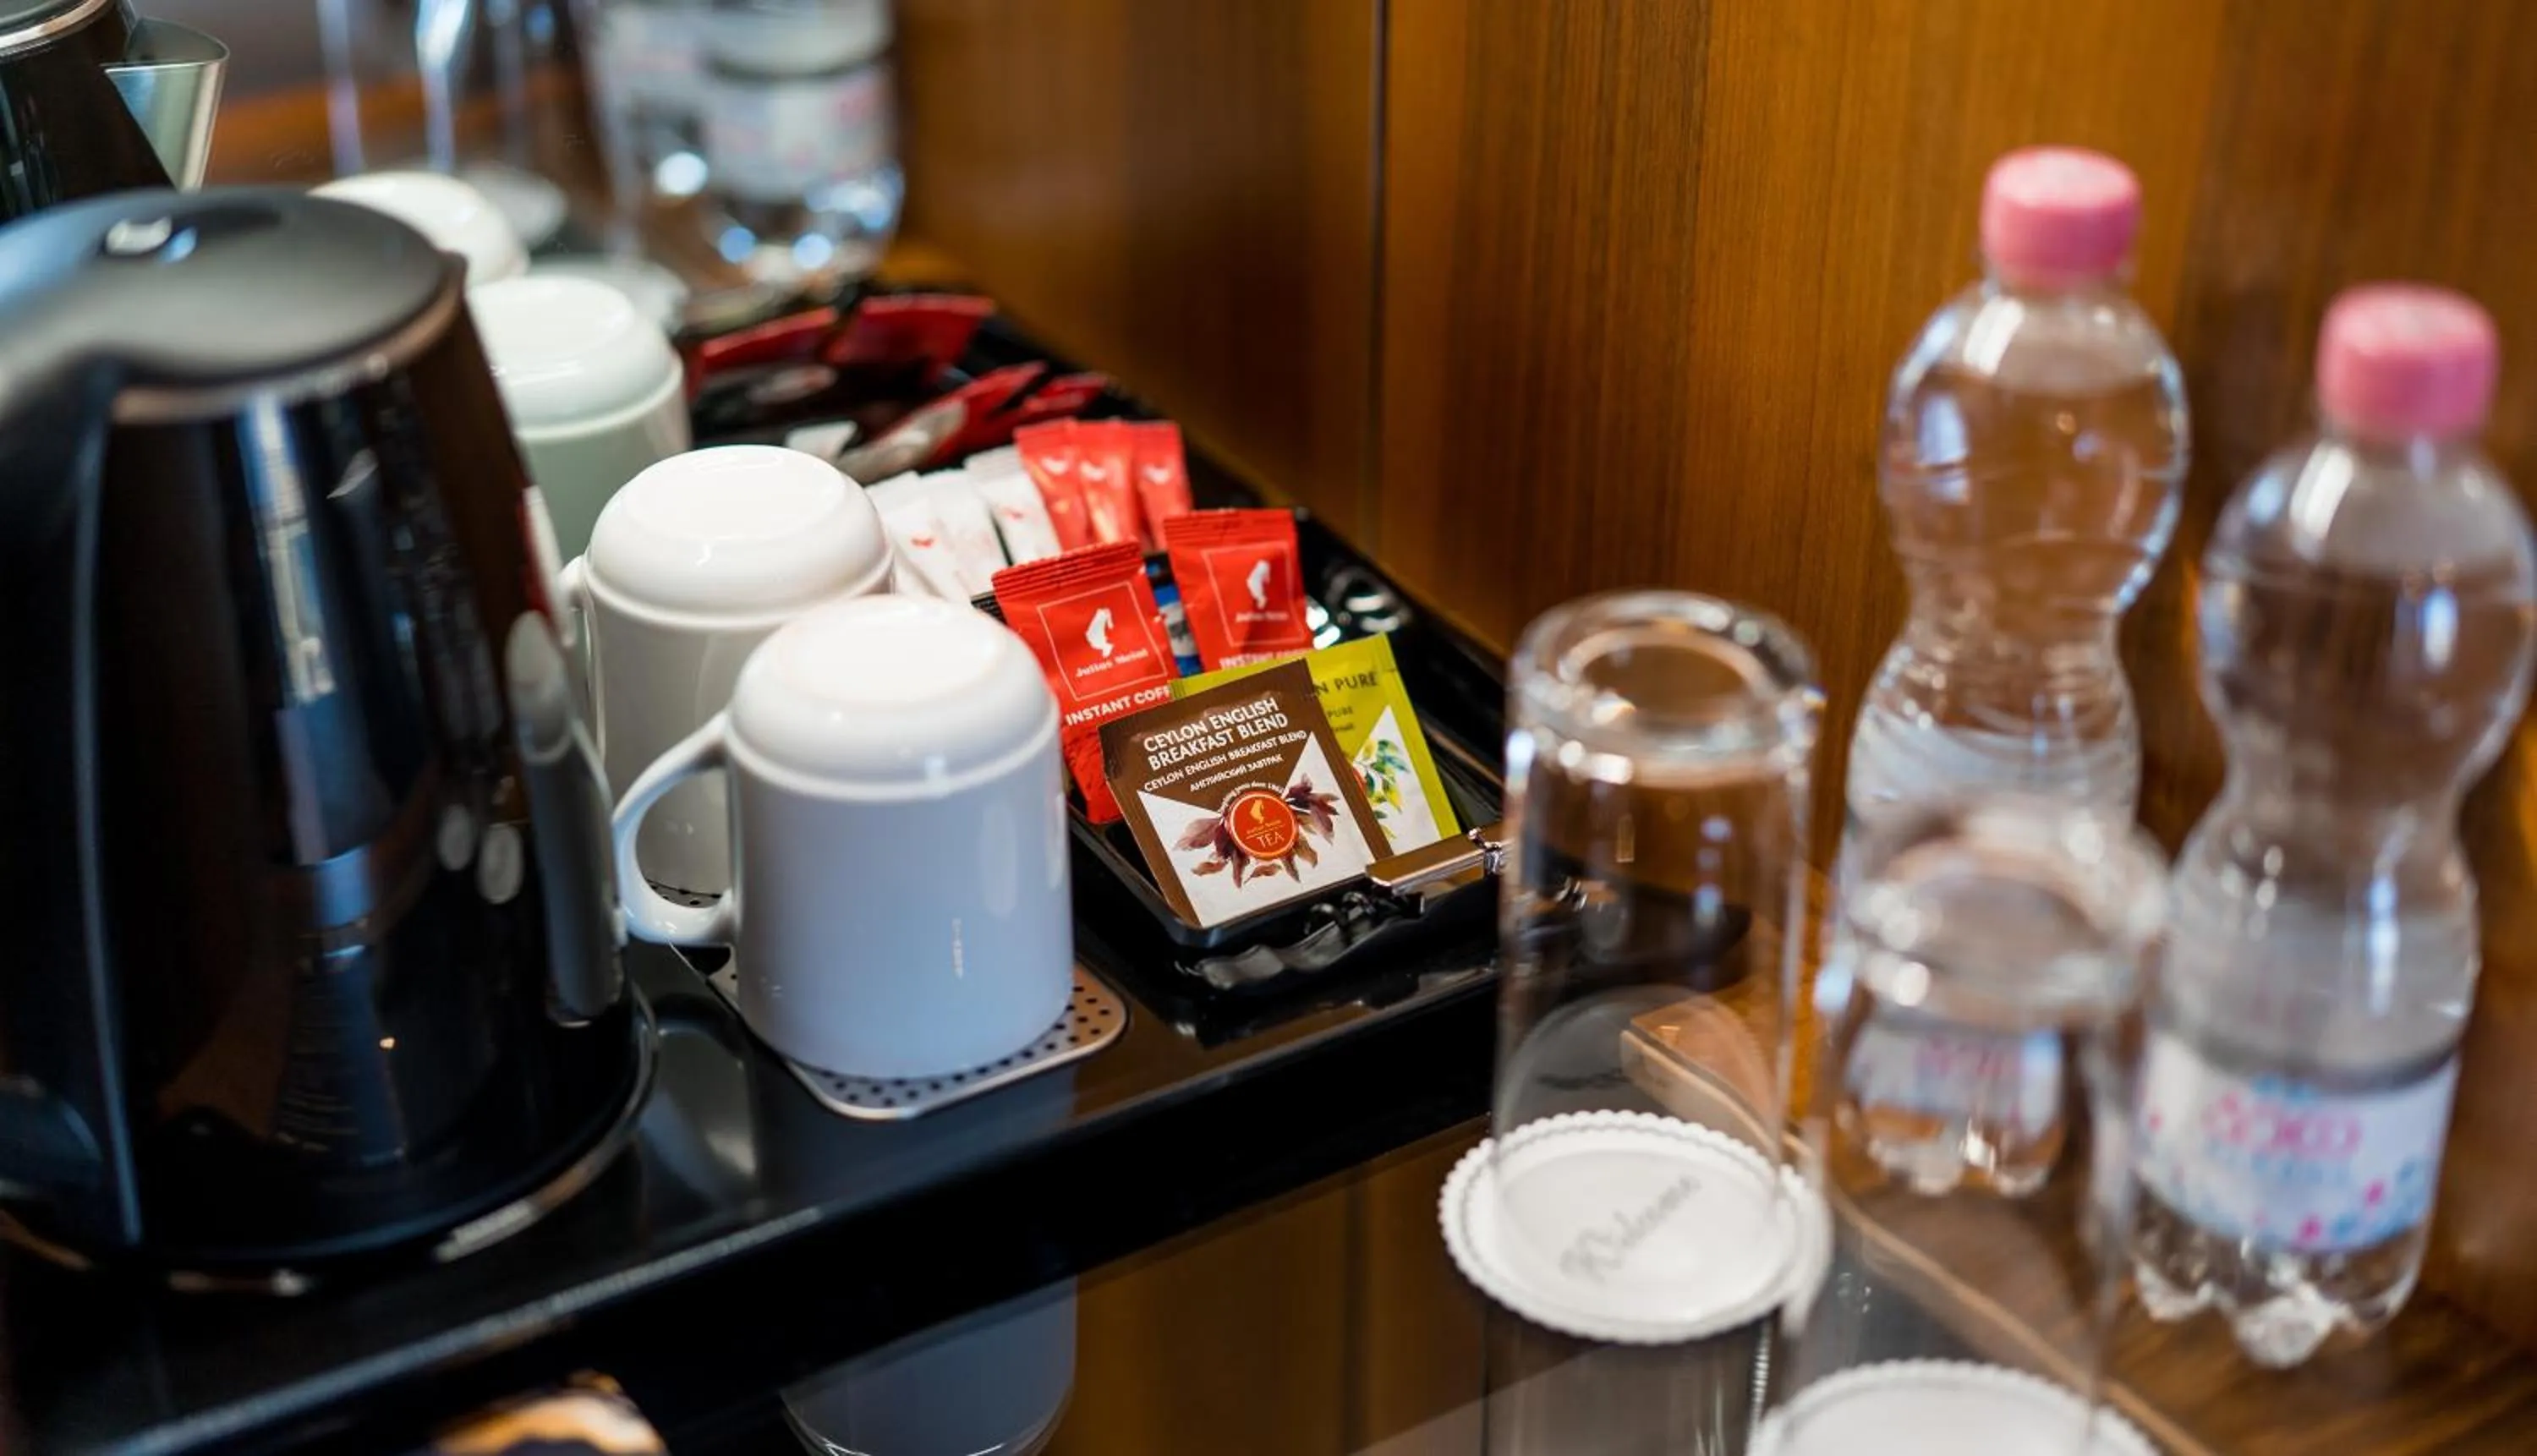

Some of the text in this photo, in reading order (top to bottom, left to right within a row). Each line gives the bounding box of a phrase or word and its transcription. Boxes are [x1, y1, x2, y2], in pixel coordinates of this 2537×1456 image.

[1334, 671, 1378, 690] PURE
[1066, 696, 1132, 725] INSTANT
[1143, 698, 1279, 752] CEYLON ENGLISH
[1148, 713, 1288, 770] BREAKFAST BLEND
[1144, 730, 1307, 792] CEYLON ENGLISH BREAKFAST BLEND
[1247, 753, 1283, 772] ЗАВТРАК
[1257, 831, 1285, 848] TEA
